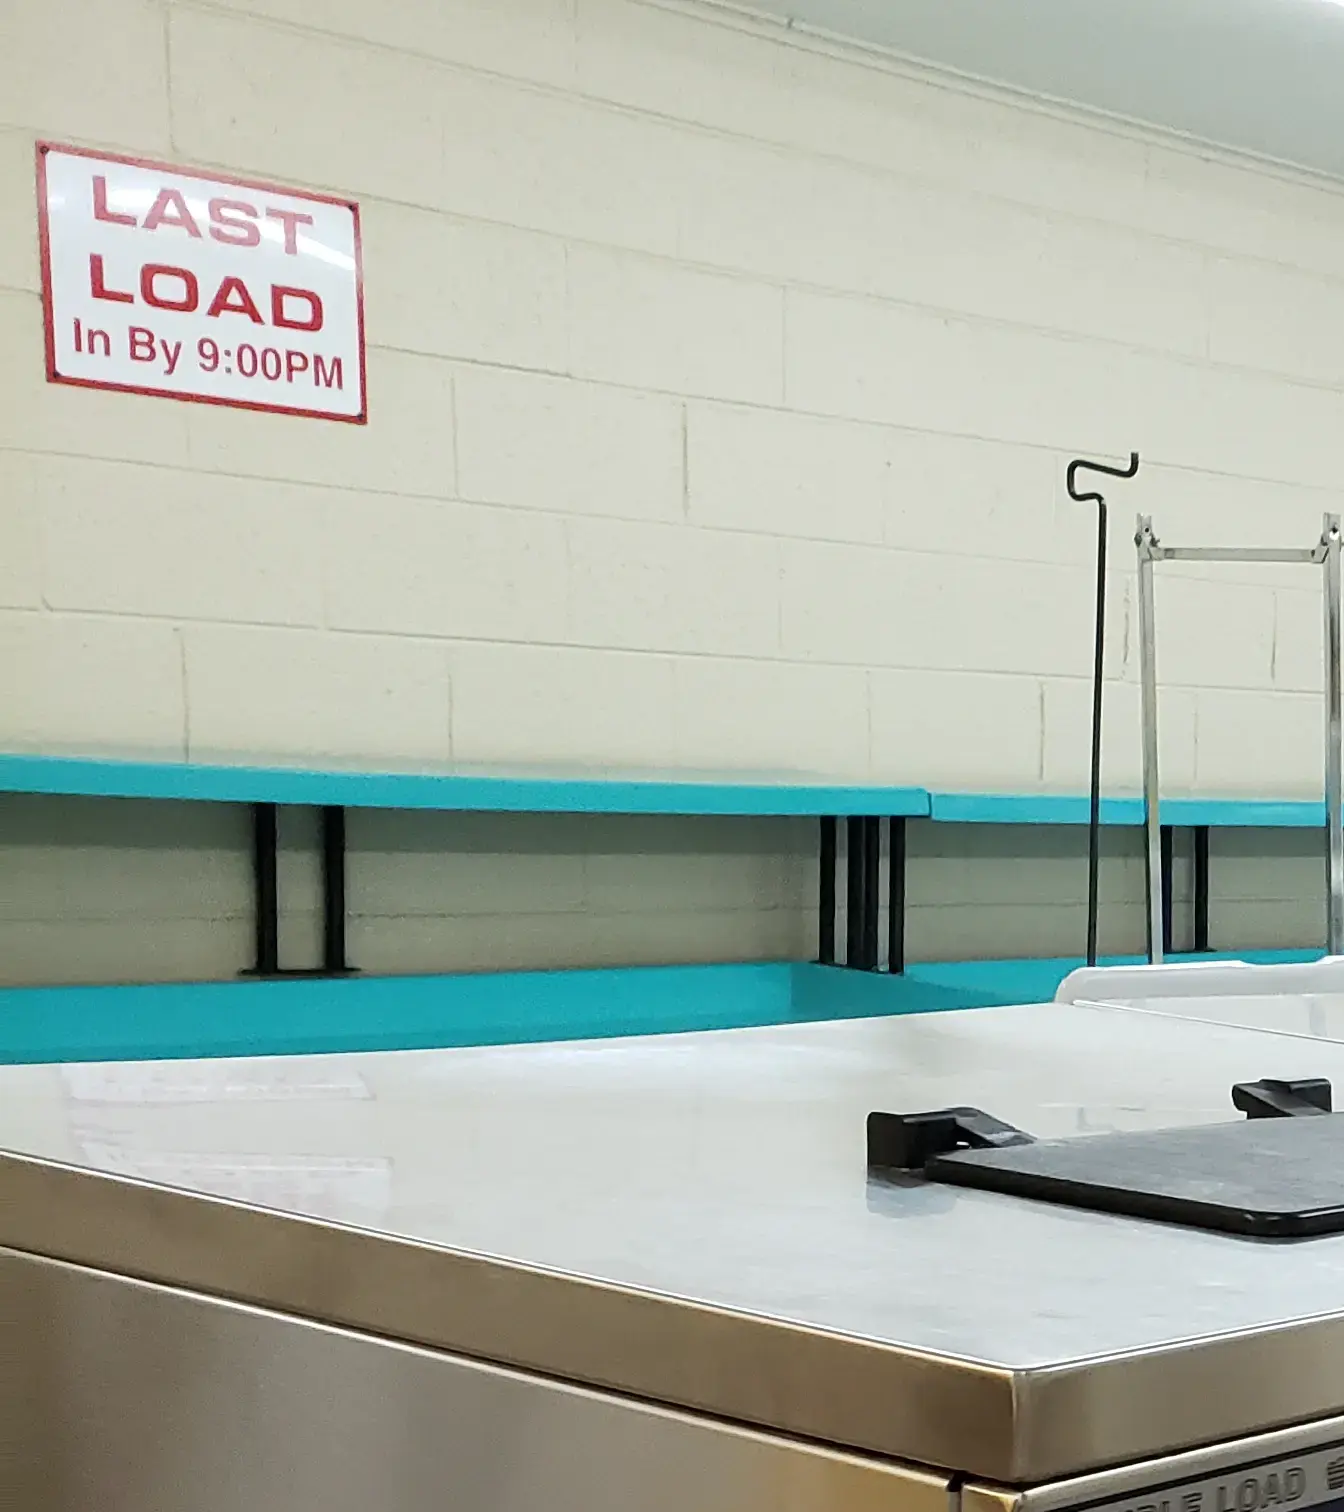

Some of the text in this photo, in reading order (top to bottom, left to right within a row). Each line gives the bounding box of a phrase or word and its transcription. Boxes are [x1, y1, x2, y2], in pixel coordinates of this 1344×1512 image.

[92, 175, 313, 255] LAST
[89, 253, 324, 332] LOAD
[73, 318, 344, 390] In By 9:00PM
